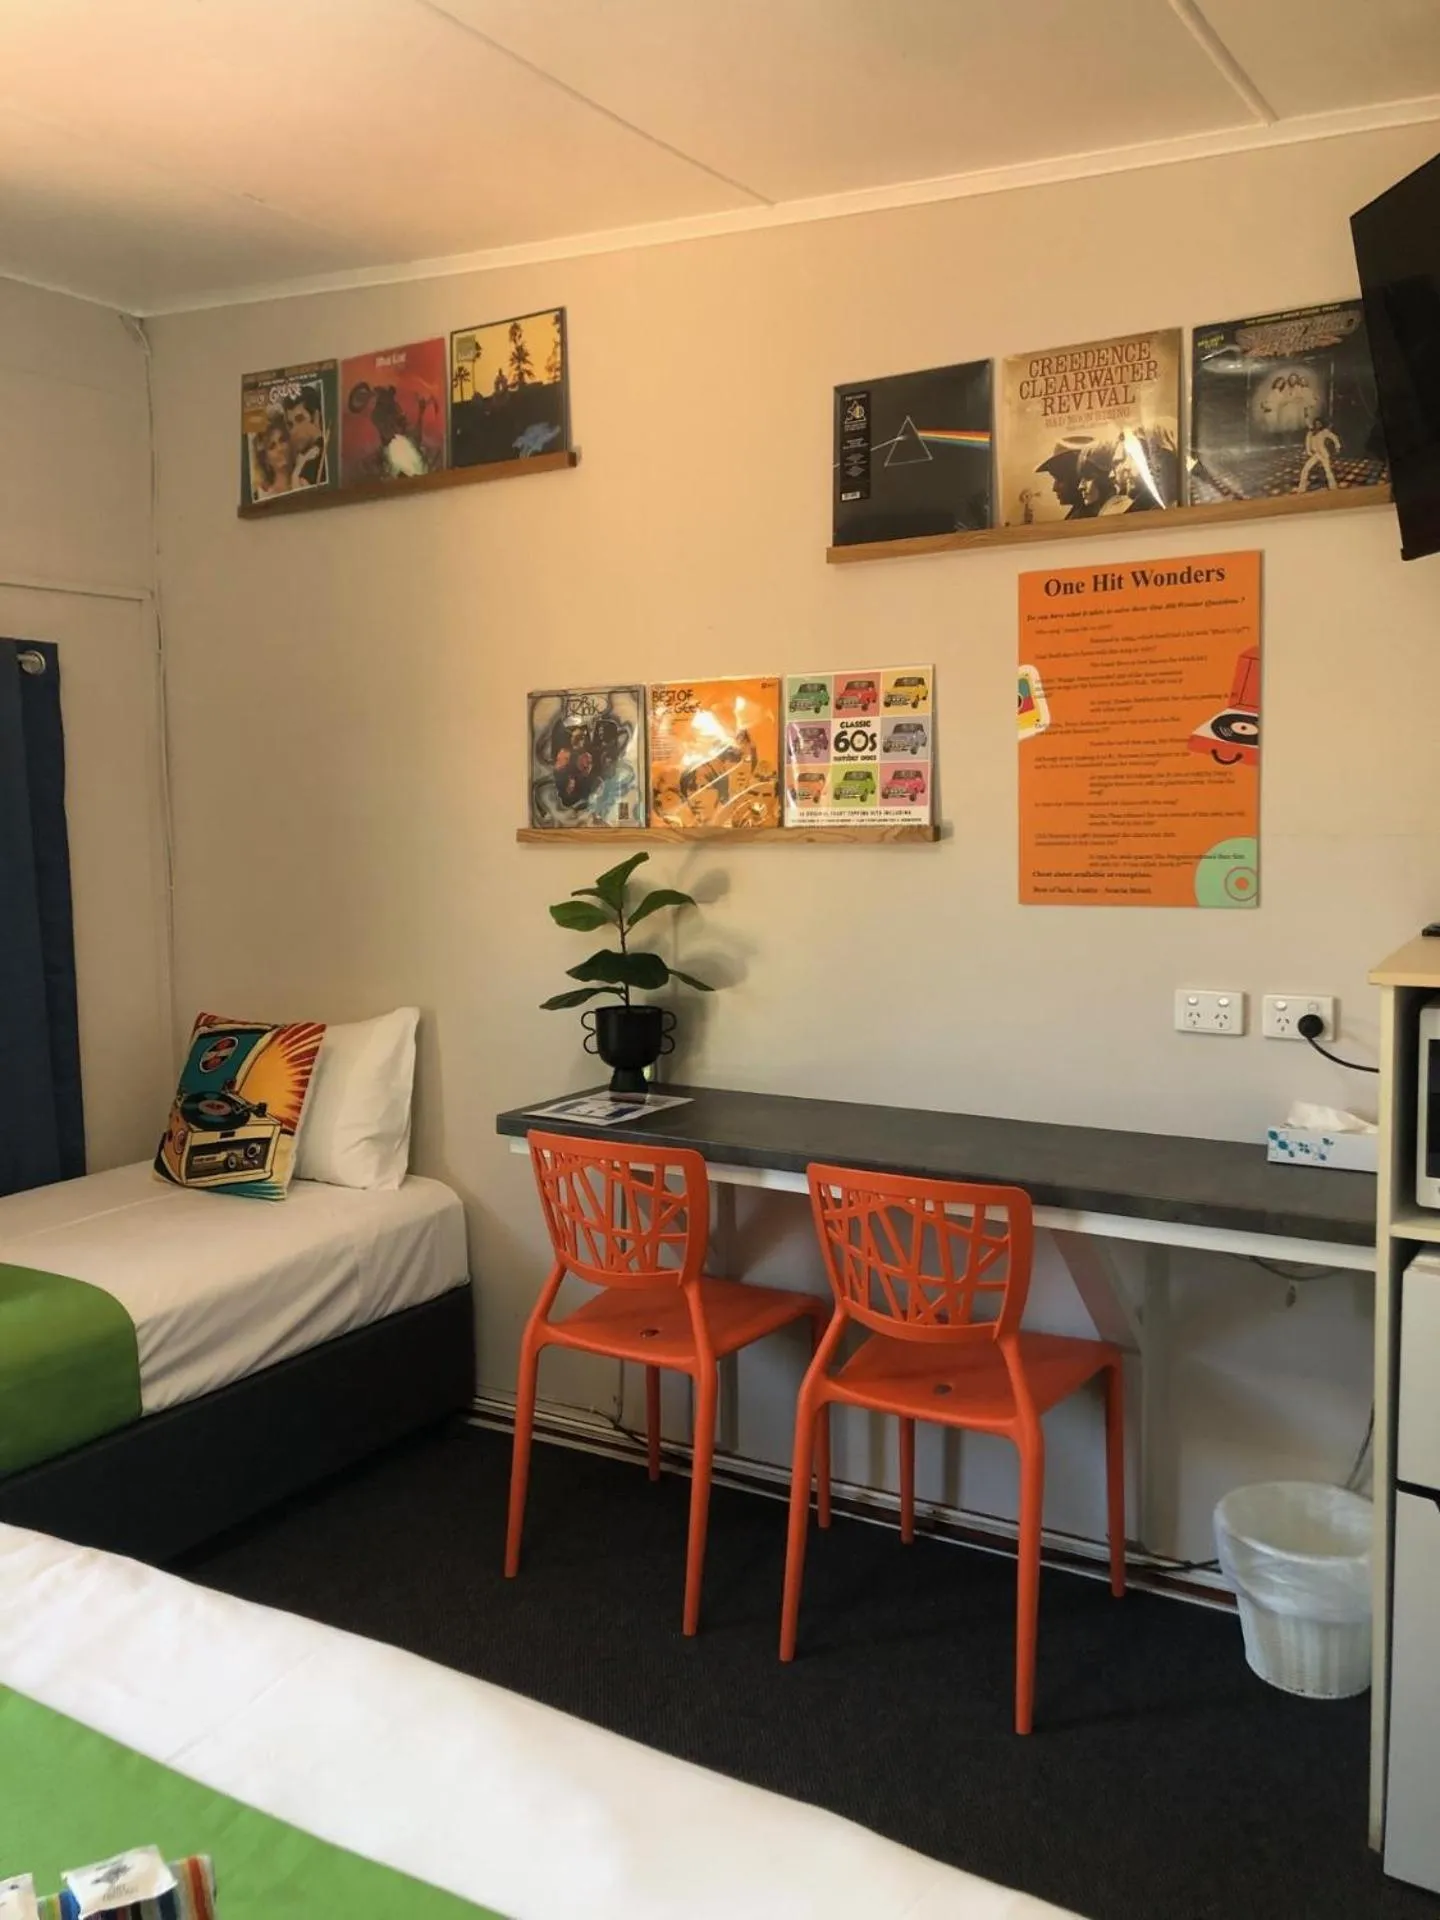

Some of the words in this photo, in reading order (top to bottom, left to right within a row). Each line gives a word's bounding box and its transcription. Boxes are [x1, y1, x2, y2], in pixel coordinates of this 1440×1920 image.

[1029, 340, 1151, 378] CREEDENCE
[1019, 360, 1159, 400] CLEARWATER
[1041, 385, 1136, 416] REVIVAL
[1044, 577, 1086, 597] One
[1092, 574, 1124, 593] Hit
[1131, 565, 1226, 589] Wonders
[652, 690, 676, 702] BEST
[677, 689, 694, 701] OF
[840, 720, 871, 729] CLASSIC
